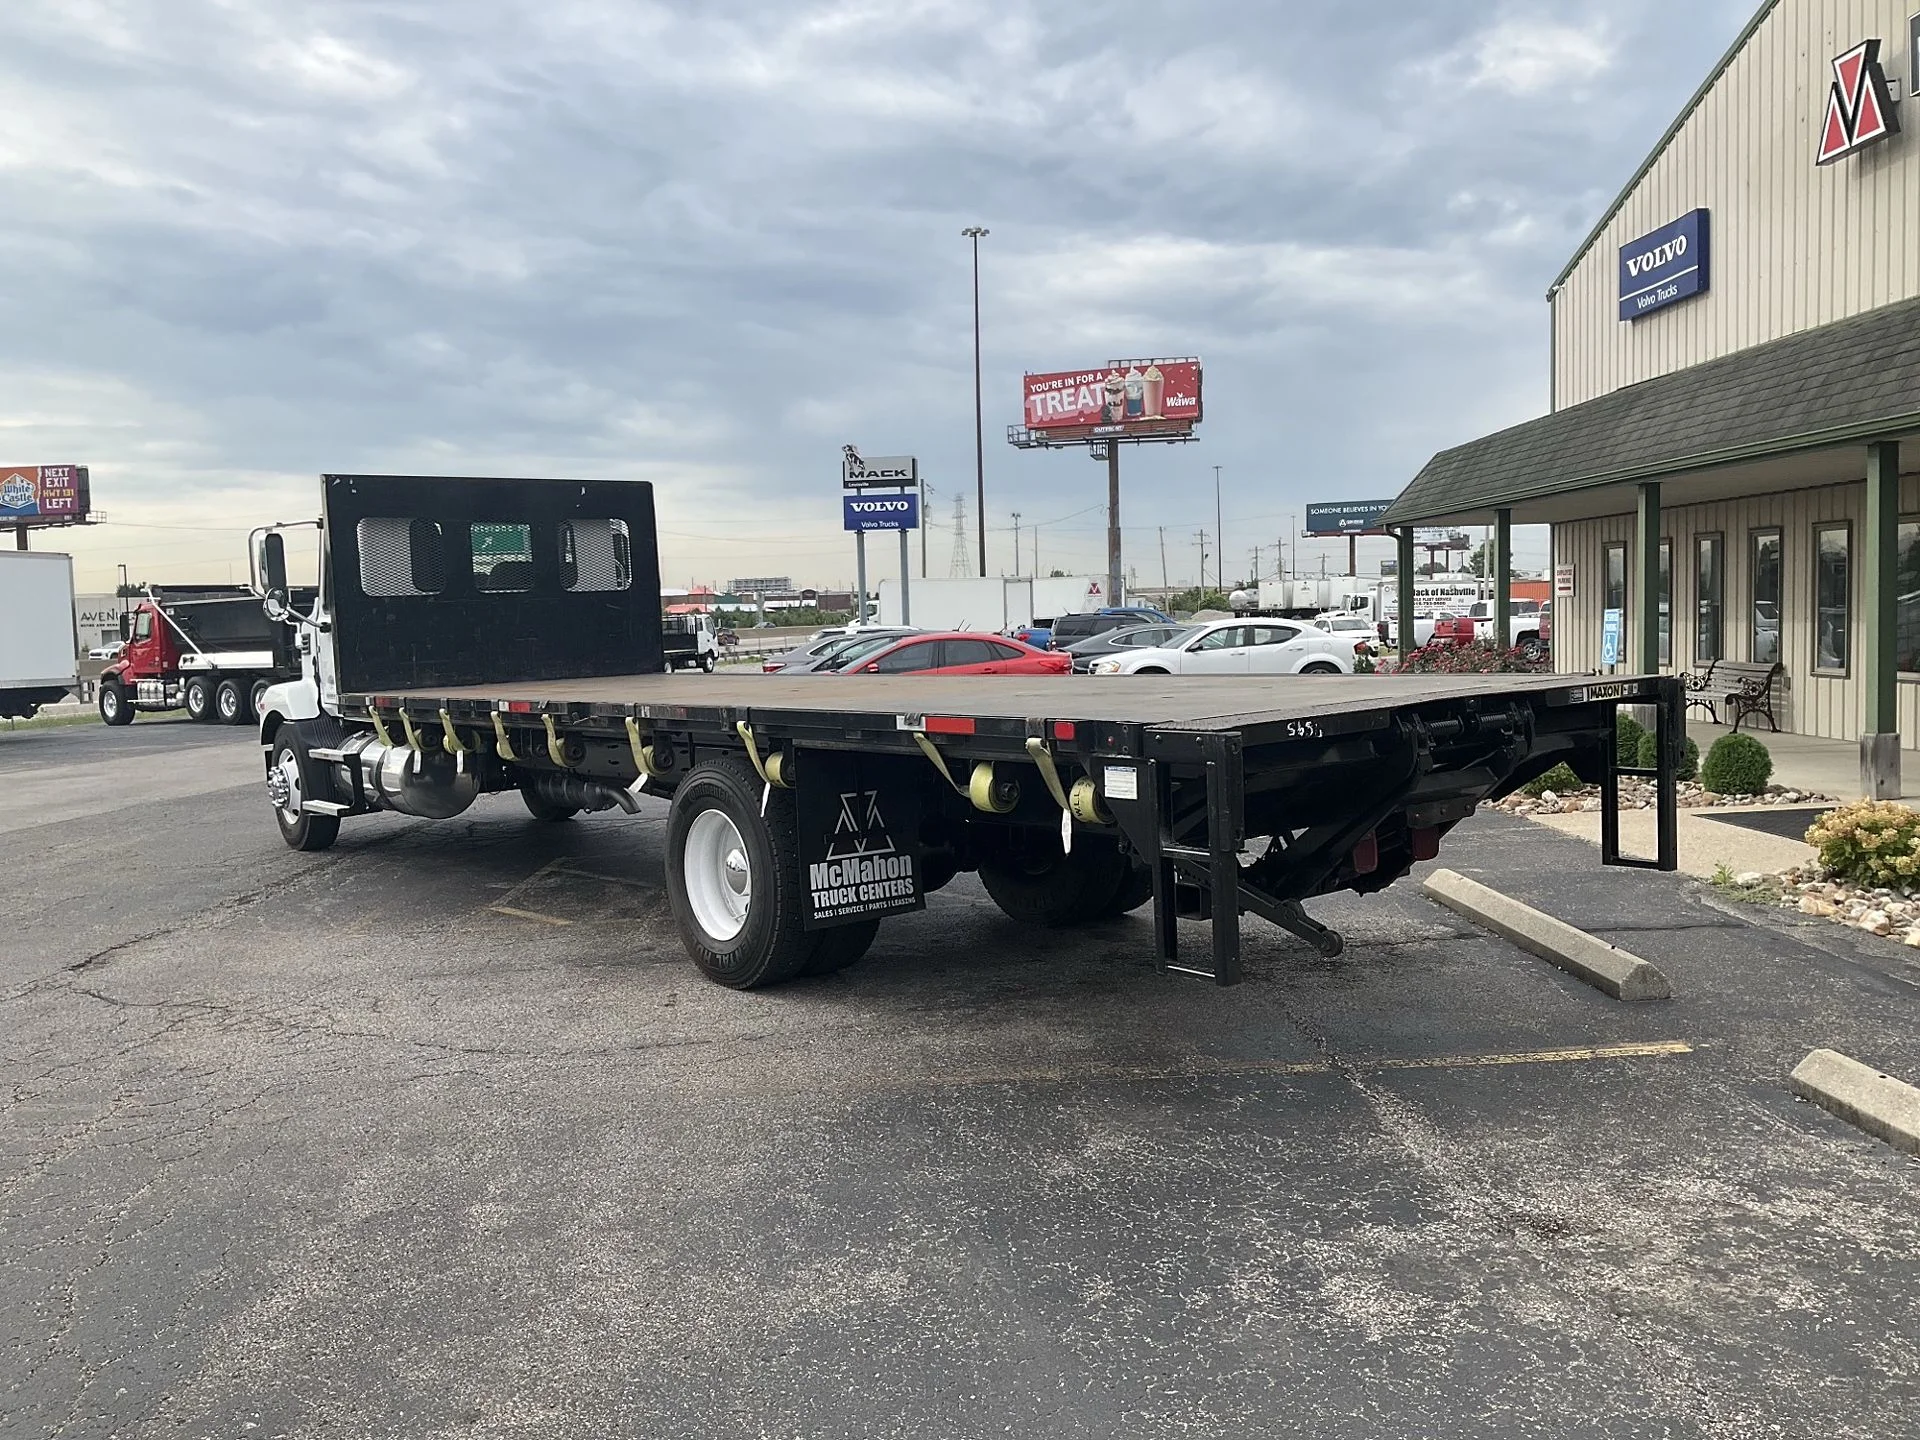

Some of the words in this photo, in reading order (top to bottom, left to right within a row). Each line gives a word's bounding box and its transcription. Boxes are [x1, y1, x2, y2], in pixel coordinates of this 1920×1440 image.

[1626, 235, 1687, 277] VOLVO
[1637, 295, 1656, 309] Volvo
[1657, 284, 1678, 302] Trucks
[1031, 380, 1063, 393] YOU'RE
[1065, 378, 1075, 387] IN
[1076, 374, 1095, 384] FOR
[1096, 372, 1103, 380] A
[1030, 382, 1106, 416] TREAT
[1166, 395, 1196, 407] Wawa
[45, 468, 70, 478] NEXT
[849, 469, 907, 478] MACK
[46, 477, 69, 488] EXIT
[4, 485, 31, 494] White
[2, 493, 33, 502] Castle
[46, 498, 72, 509] LEFT
[850, 501, 909, 512] VOLVO
[1431, 588, 1439, 596] of
[1440, 588, 1476, 596] Nashville
[1590, 684, 1620, 699] MAXON
[809, 855, 913, 891] McMahon
[811, 886, 858, 909] TRUCK
[858, 878, 914, 901] CENTERS
[813, 909, 834, 919] SALES
[838, 904, 865, 915] SERVICE
[868, 900, 888, 911] PARTS
[891, 896, 916, 907] LEASING
